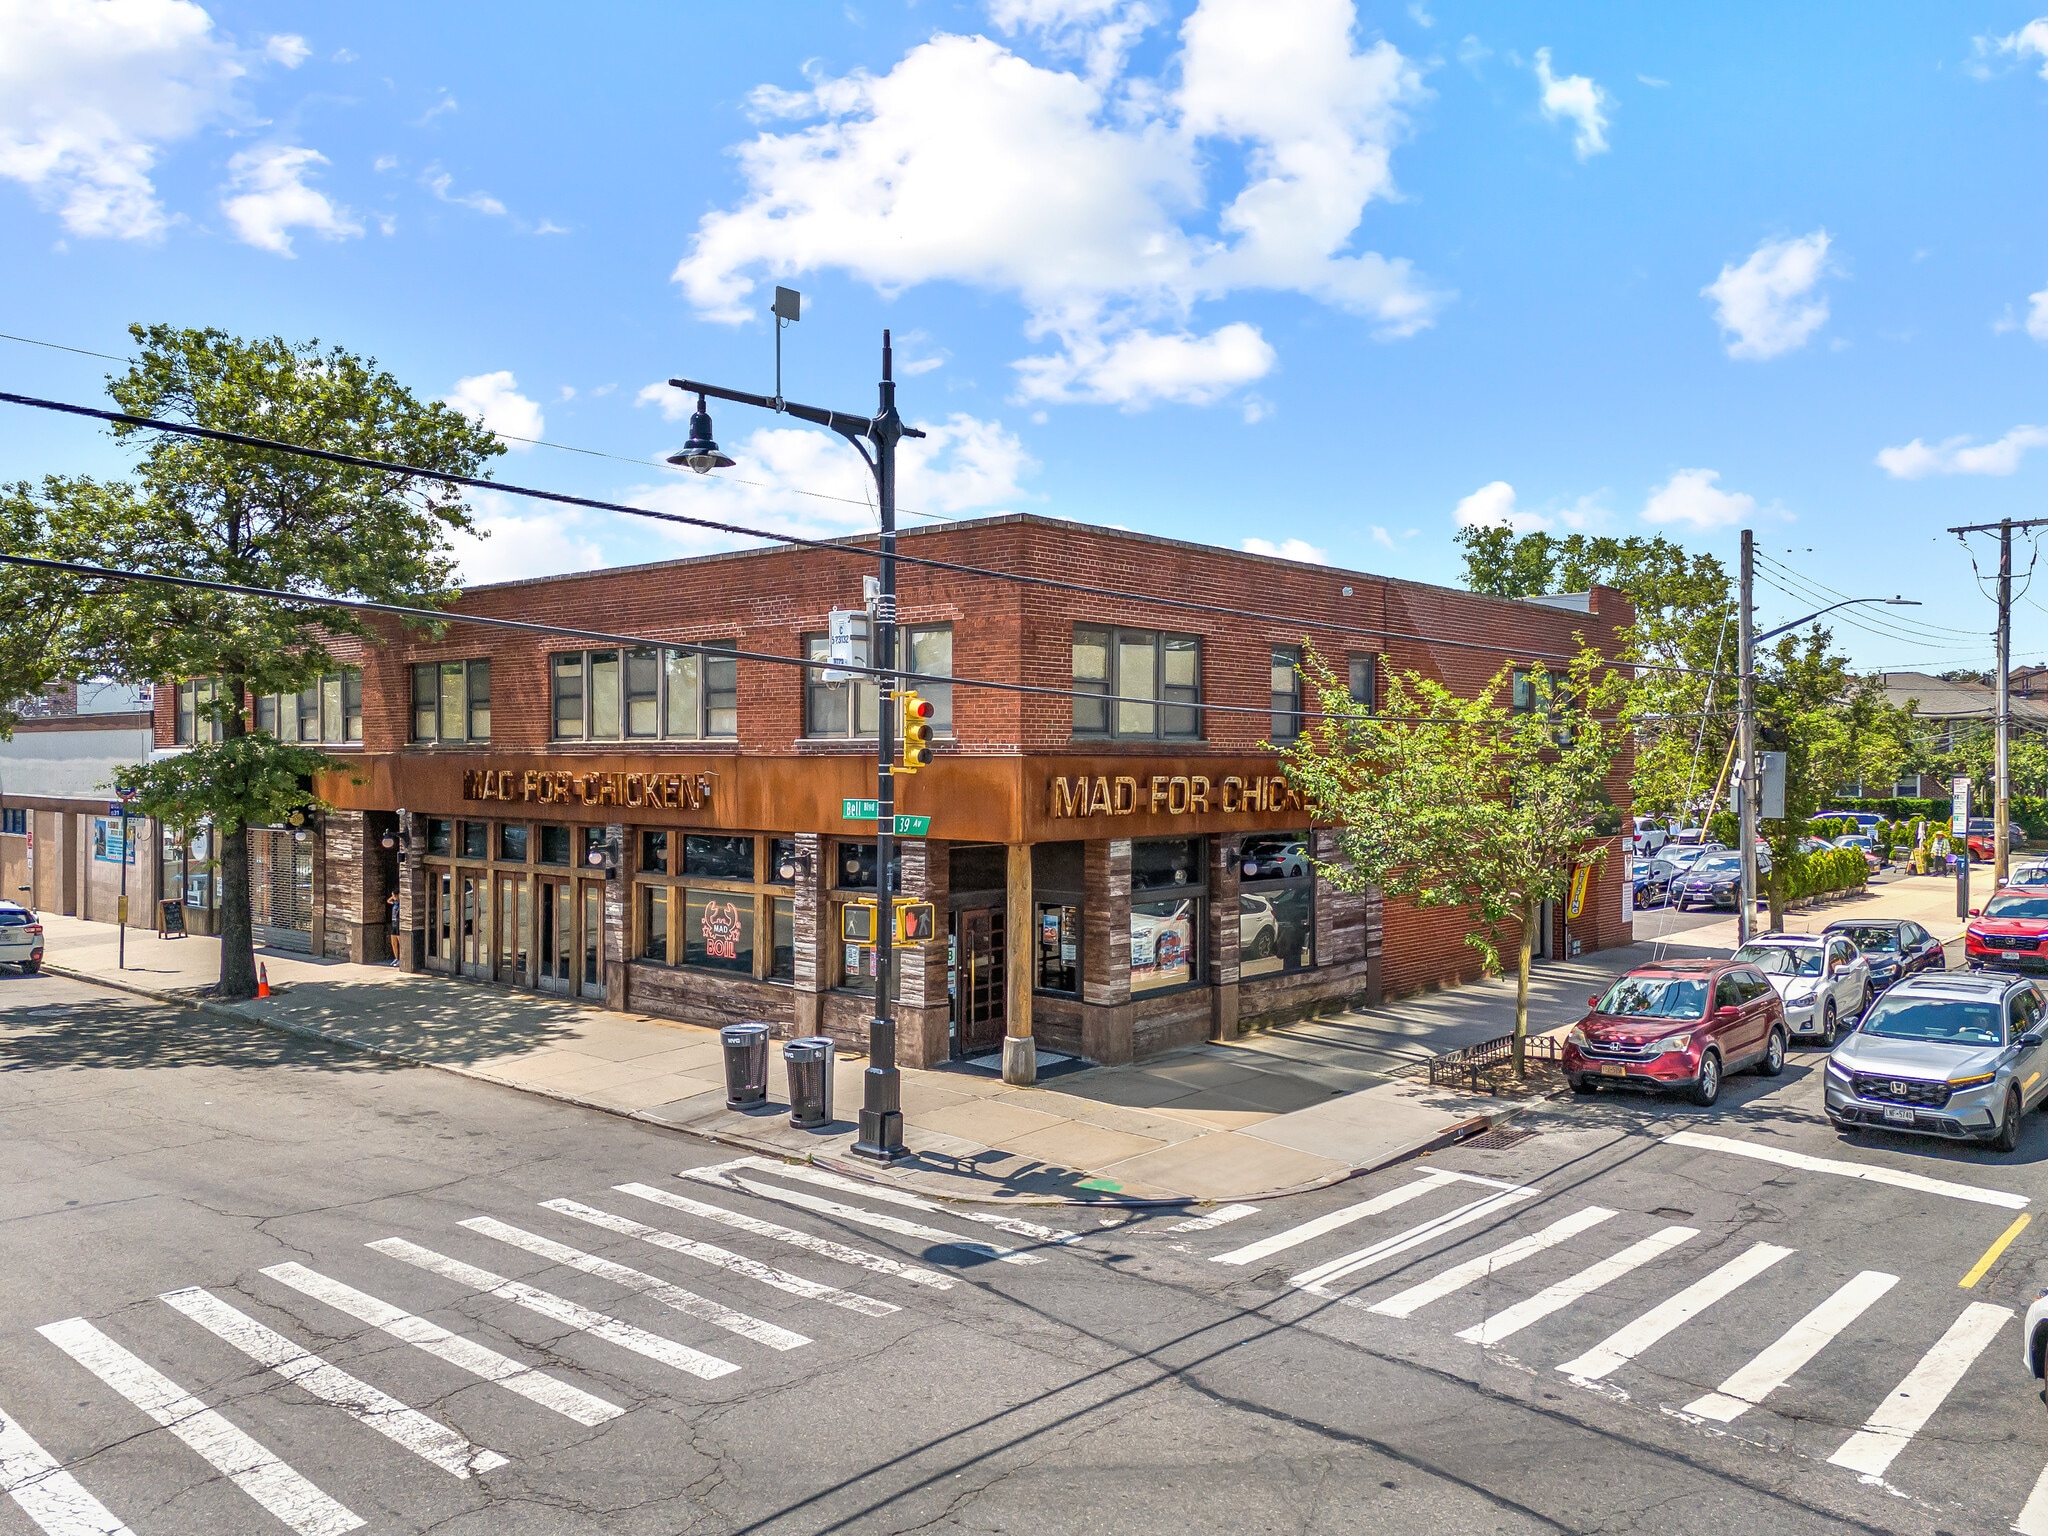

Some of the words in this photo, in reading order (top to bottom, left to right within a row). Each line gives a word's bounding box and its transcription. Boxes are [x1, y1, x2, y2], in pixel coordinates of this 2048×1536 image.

[463, 770, 514, 800] MAD
[524, 770, 572, 805] FOR
[582, 771, 706, 811] CHICKEN
[1054, 776, 1138, 818] MAD
[1151, 775, 1210, 815] FOR
[1222, 776, 1324, 813] CHICK
[846, 801, 861, 817] Bell
[863, 802, 875, 812] Blvd
[899, 817, 910, 833] 39
[912, 819, 922, 828] Av
[1571, 870, 1584, 914] LEASING
[713, 924, 729, 934] MAD
[706, 939, 736, 959] BOIL
